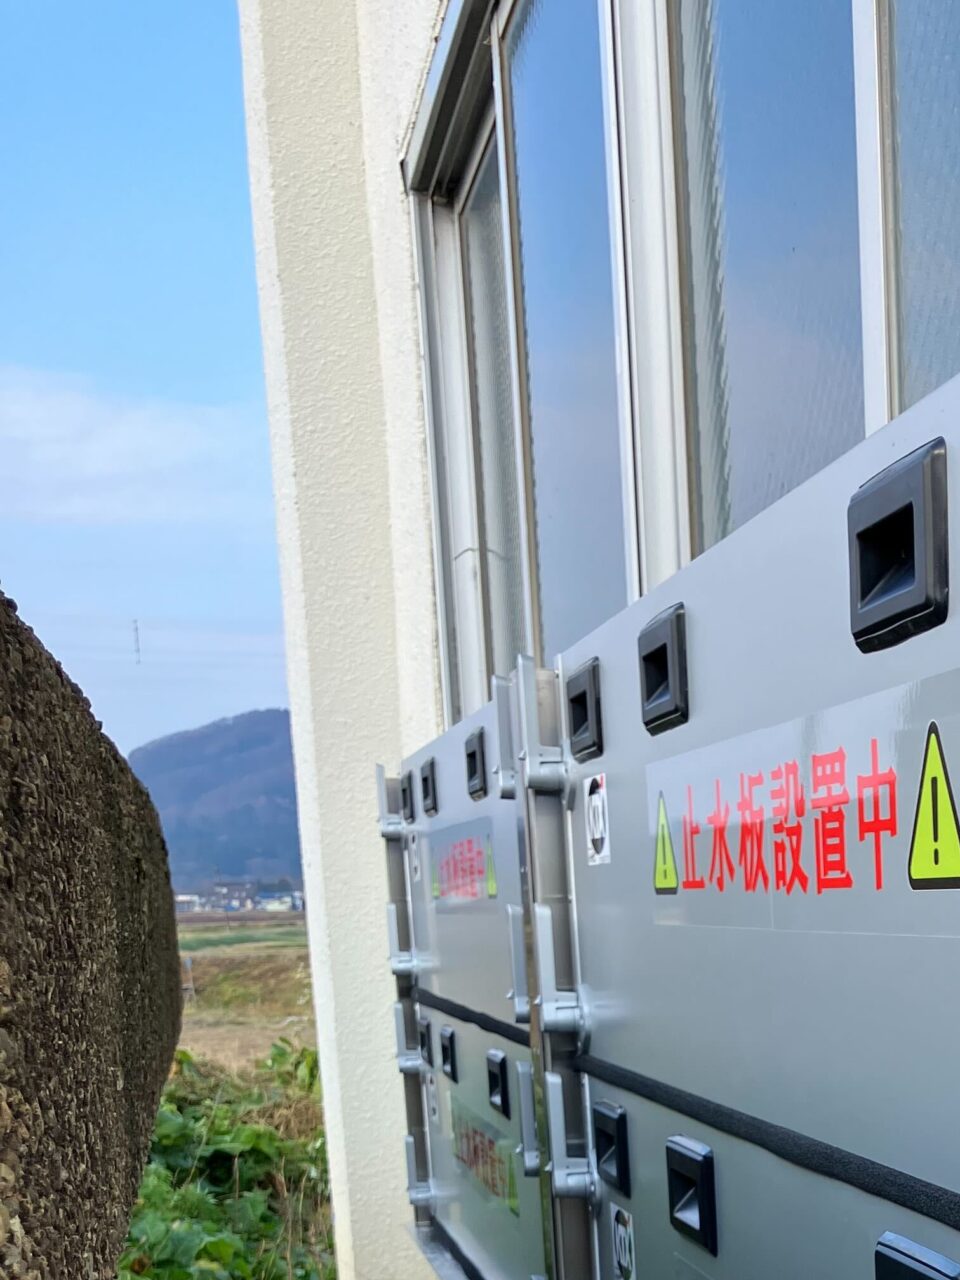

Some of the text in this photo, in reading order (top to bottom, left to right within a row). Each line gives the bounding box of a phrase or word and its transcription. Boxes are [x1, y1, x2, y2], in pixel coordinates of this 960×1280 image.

[681, 737, 899, 896] 止水板設置中
